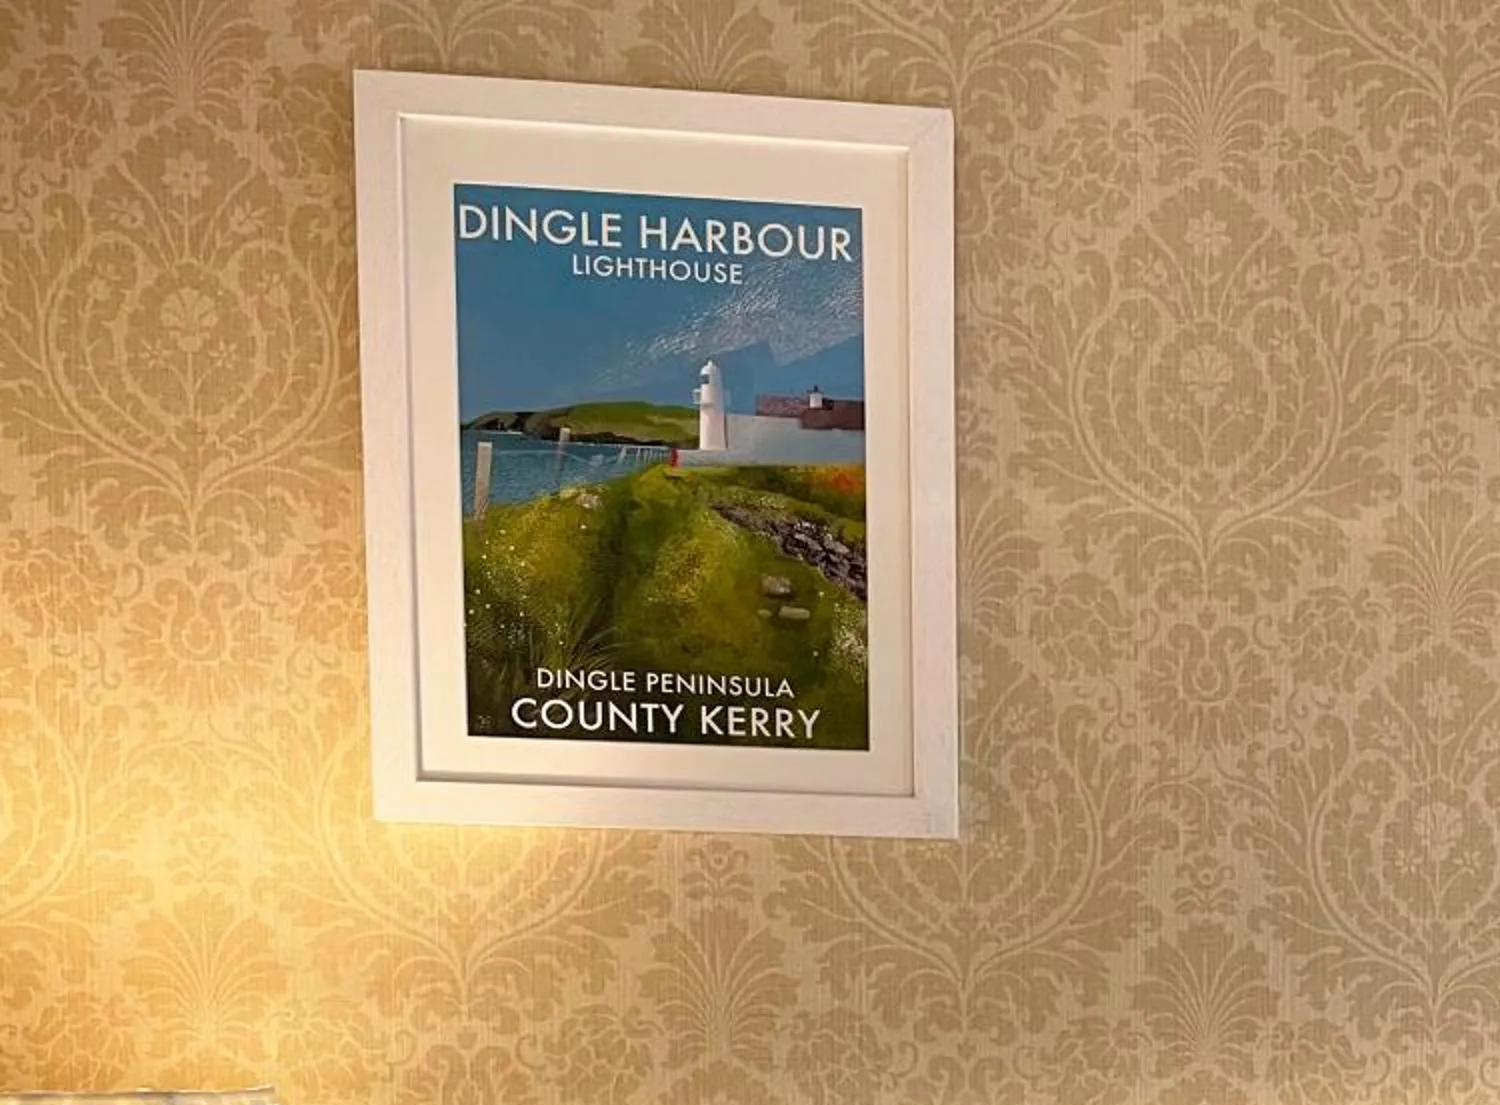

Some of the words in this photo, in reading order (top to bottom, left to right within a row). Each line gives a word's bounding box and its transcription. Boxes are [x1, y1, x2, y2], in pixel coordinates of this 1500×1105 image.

[458, 204, 623, 248] DINGLE
[639, 215, 854, 262] HARBOUR
[572, 253, 744, 285] LIGHTHOUSE
[536, 668, 636, 693] DINGLE
[647, 672, 795, 699] PENINSULA
[510, 697, 685, 733] COUNTY
[700, 705, 821, 740] KERRY
